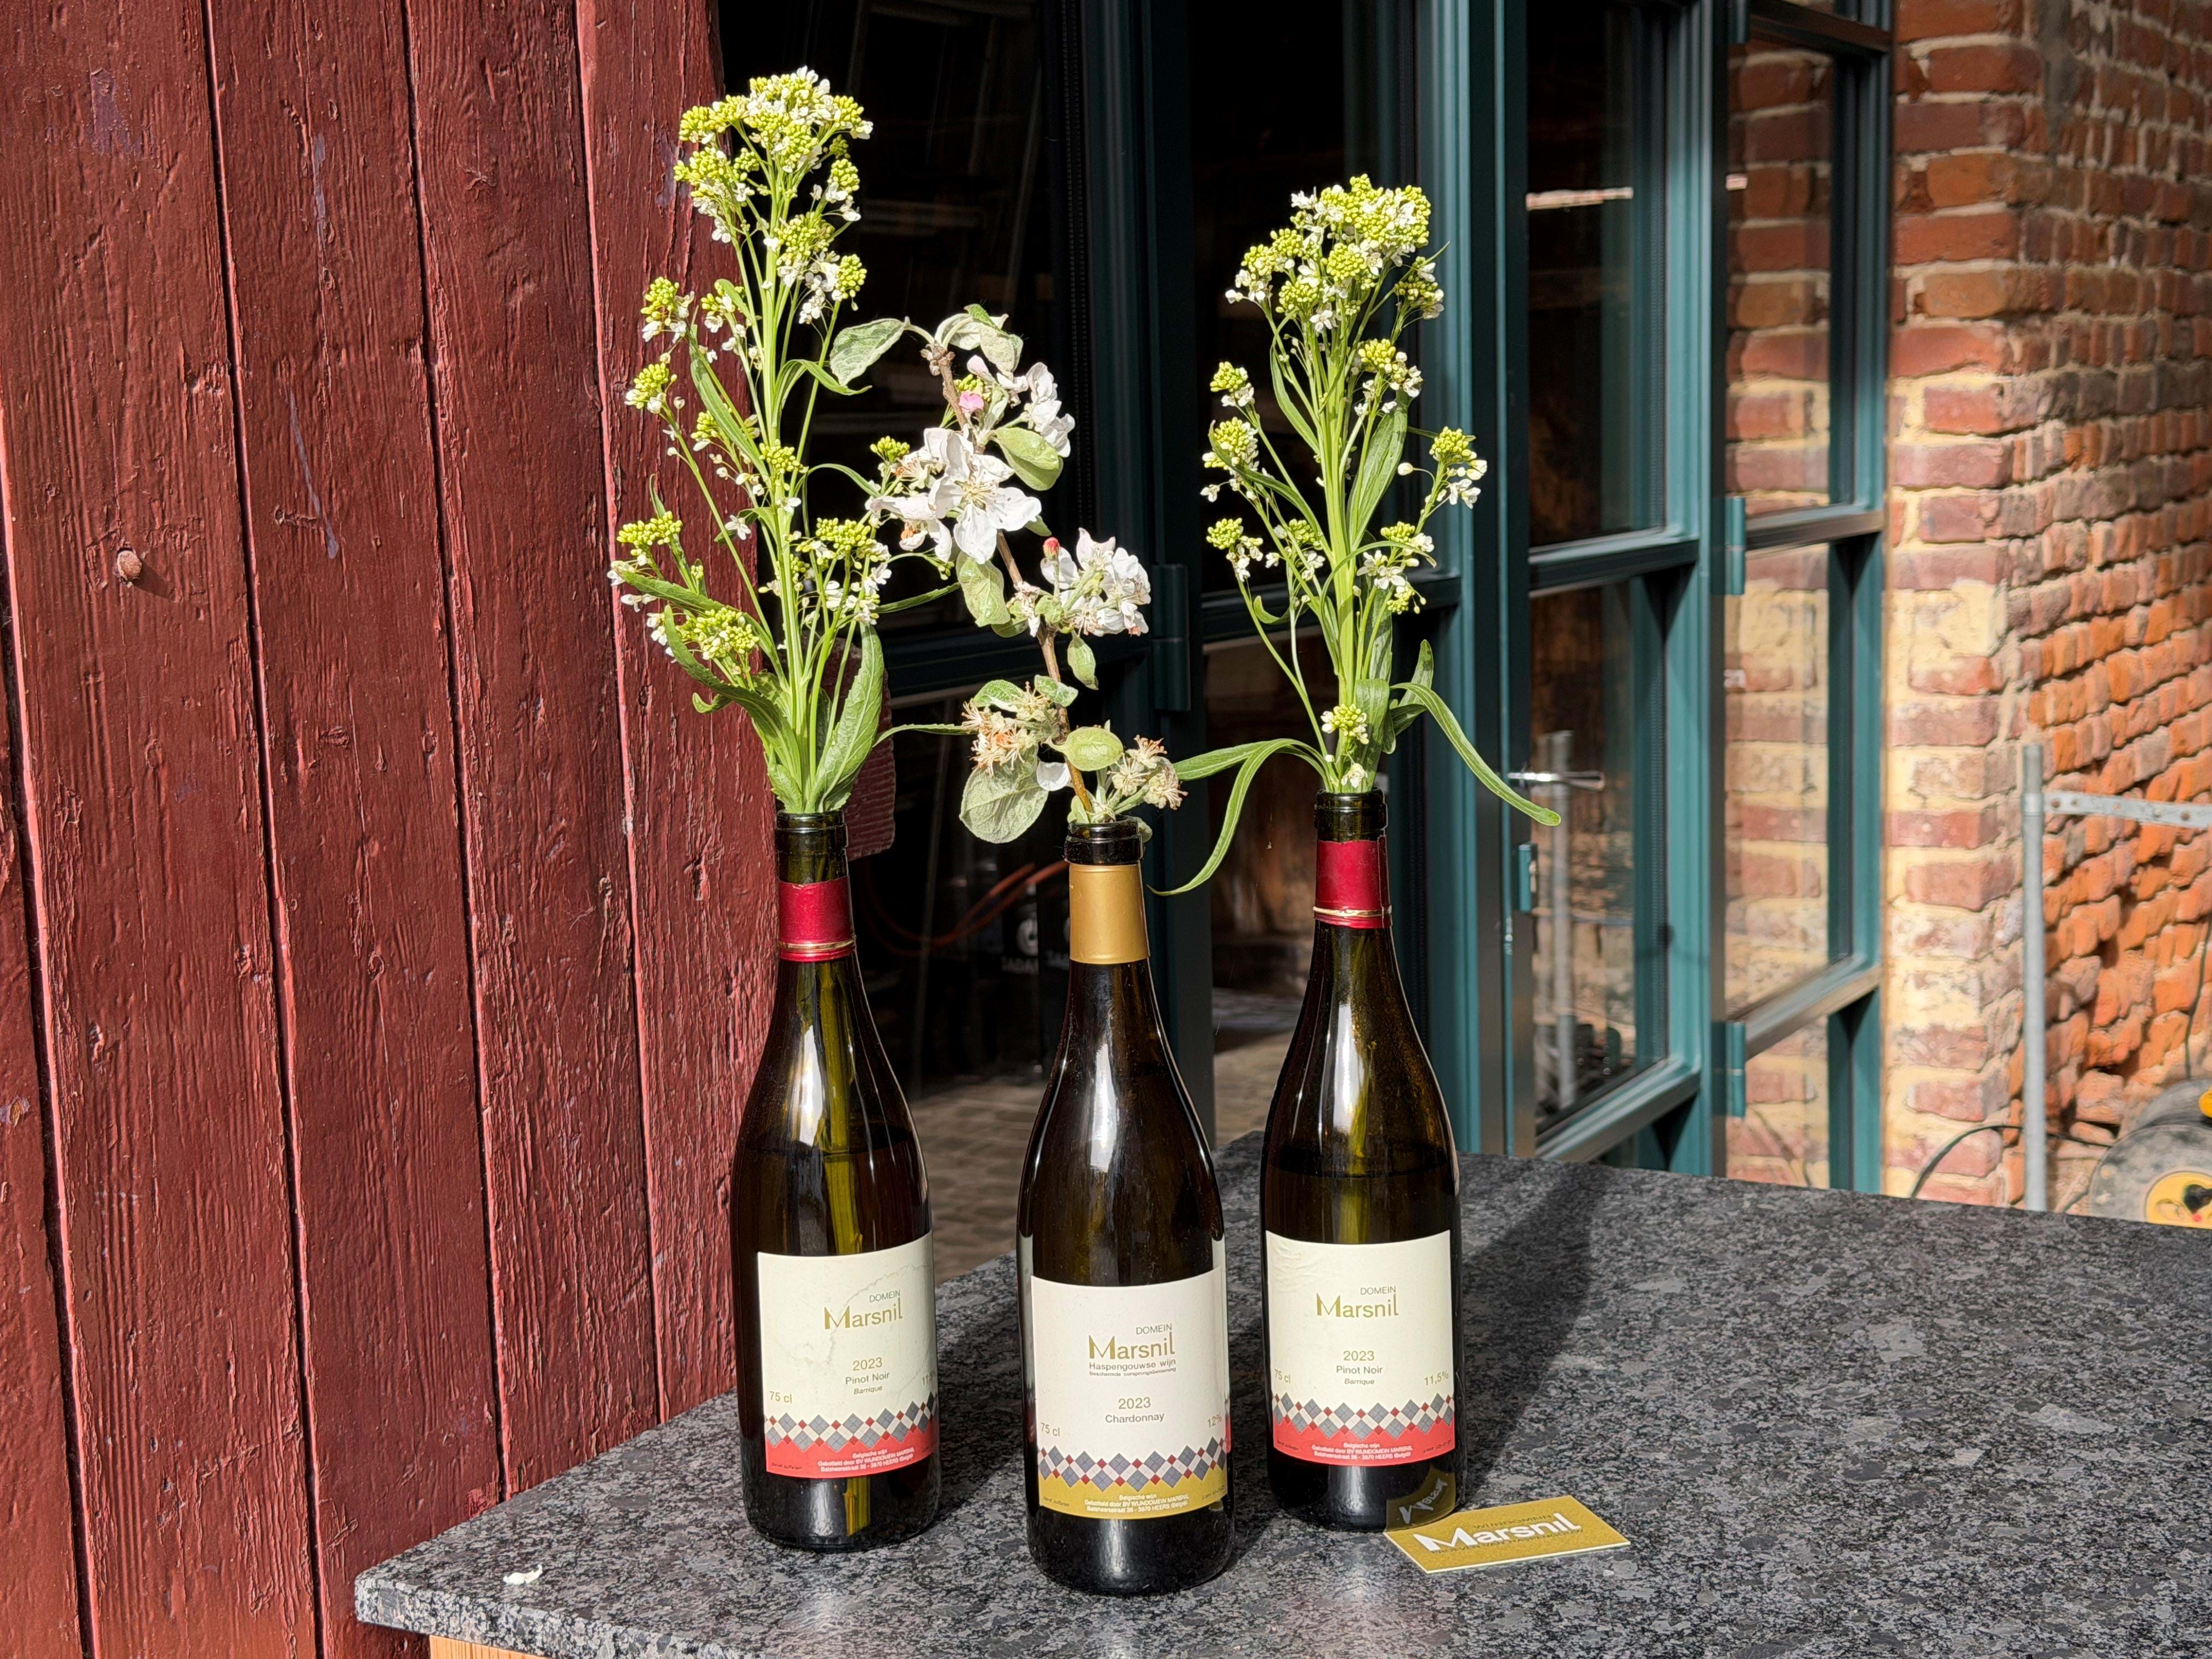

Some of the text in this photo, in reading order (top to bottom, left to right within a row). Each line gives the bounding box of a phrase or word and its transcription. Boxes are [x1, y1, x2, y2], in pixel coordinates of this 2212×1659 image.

[869, 1289, 900, 1302] DOMEIN
[1360, 1286, 1396, 1295] DOMEIN
[1316, 1293, 1399, 1318] Marsnil
[824, 1297, 903, 1329] Marsnil
[1136, 1323, 1172, 1335] DOMEIN
[1088, 1331, 1175, 1359] Marsnil
[1343, 1350, 1375, 1361] 2023
[853, 1357, 882, 1371] 2023
[1089, 1358, 1176, 1372] Haspengouwse wijn
[1336, 1365, 1383, 1374] Pinot Noir
[845, 1372, 890, 1385] Pinot Noir
[1274, 1369, 1290, 1384] 75 cl
[1344, 1378, 1375, 1386] Barrique
[1424, 1369, 1449, 1385] 11,5%
[769, 1391, 792, 1403] 75 cl
[854, 1386, 883, 1395] Barrique
[1118, 1397, 1151, 1409] 2023
[1105, 1413, 1165, 1423] Chardonnay
[1207, 1414, 1222, 1427] 12%
[1040, 1421, 1060, 1437] 75 cl
[1473, 1514, 1552, 1529] WIJNDOMEIN
[1412, 1512, 1581, 1552] Marsnil
